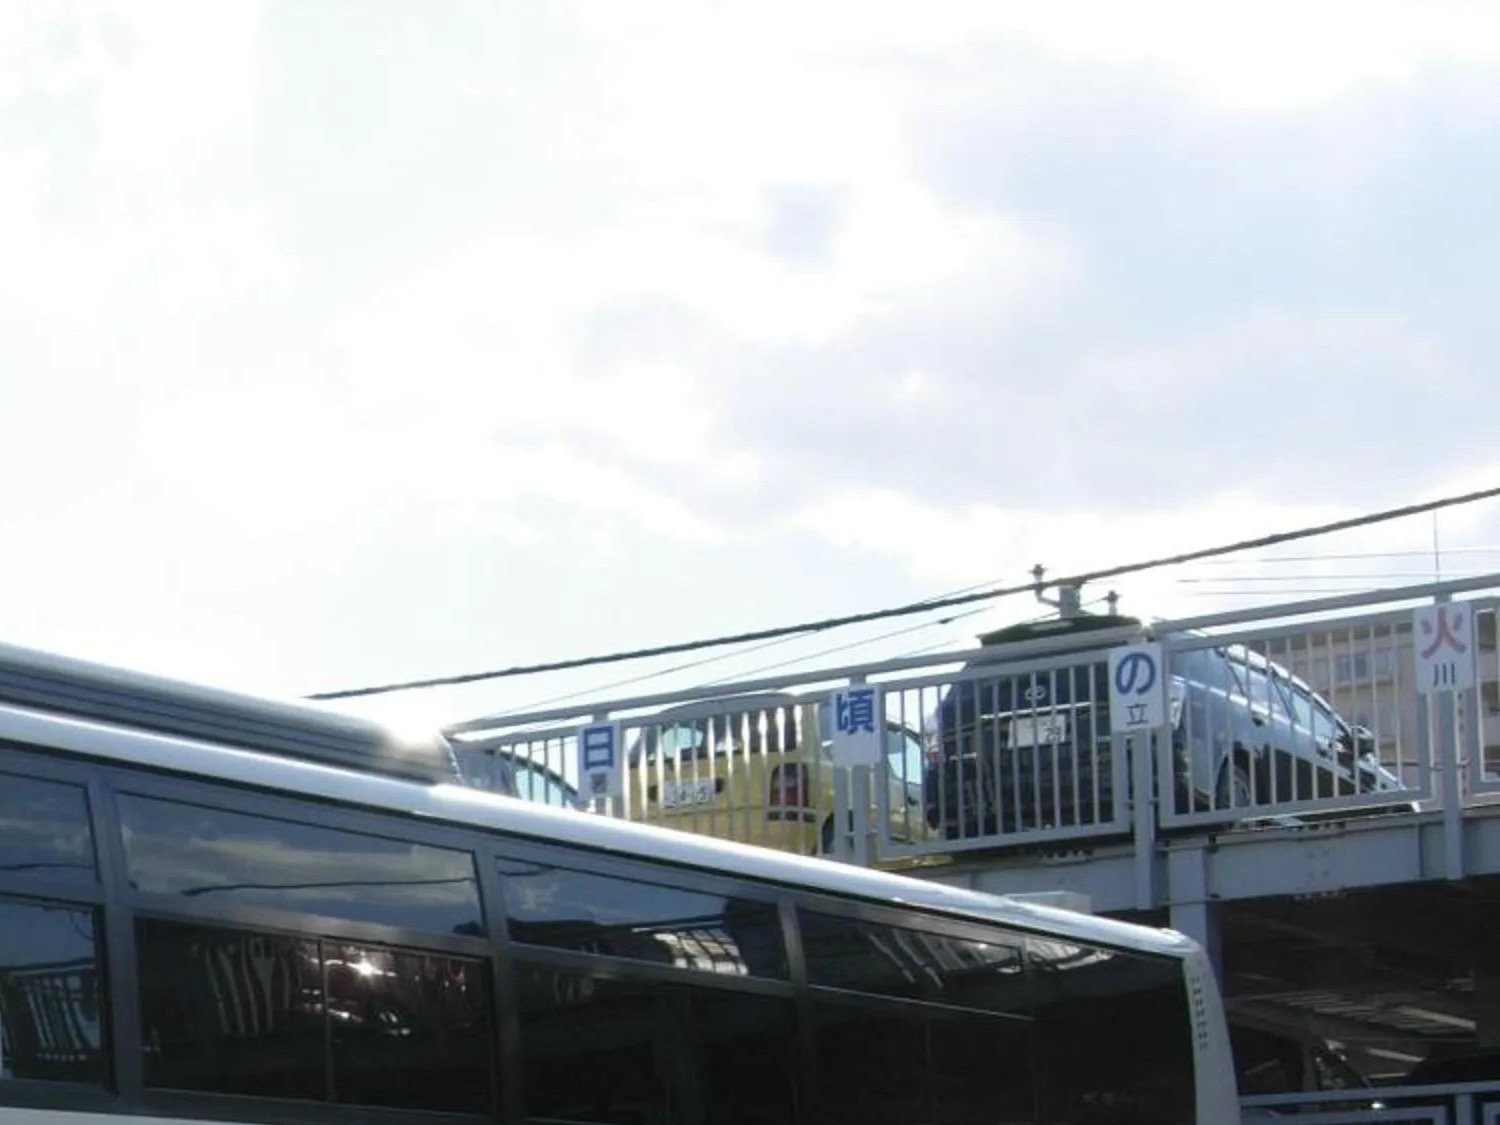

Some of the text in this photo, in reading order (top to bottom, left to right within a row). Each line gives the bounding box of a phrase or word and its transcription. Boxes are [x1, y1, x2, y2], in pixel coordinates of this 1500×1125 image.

[1421, 606, 1467, 660] 火
[1115, 651, 1156, 696] の
[1432, 663, 1457, 688] 川
[835, 688, 875, 735] 頃
[1123, 702, 1149, 726] 立
[583, 726, 614, 770] 日
